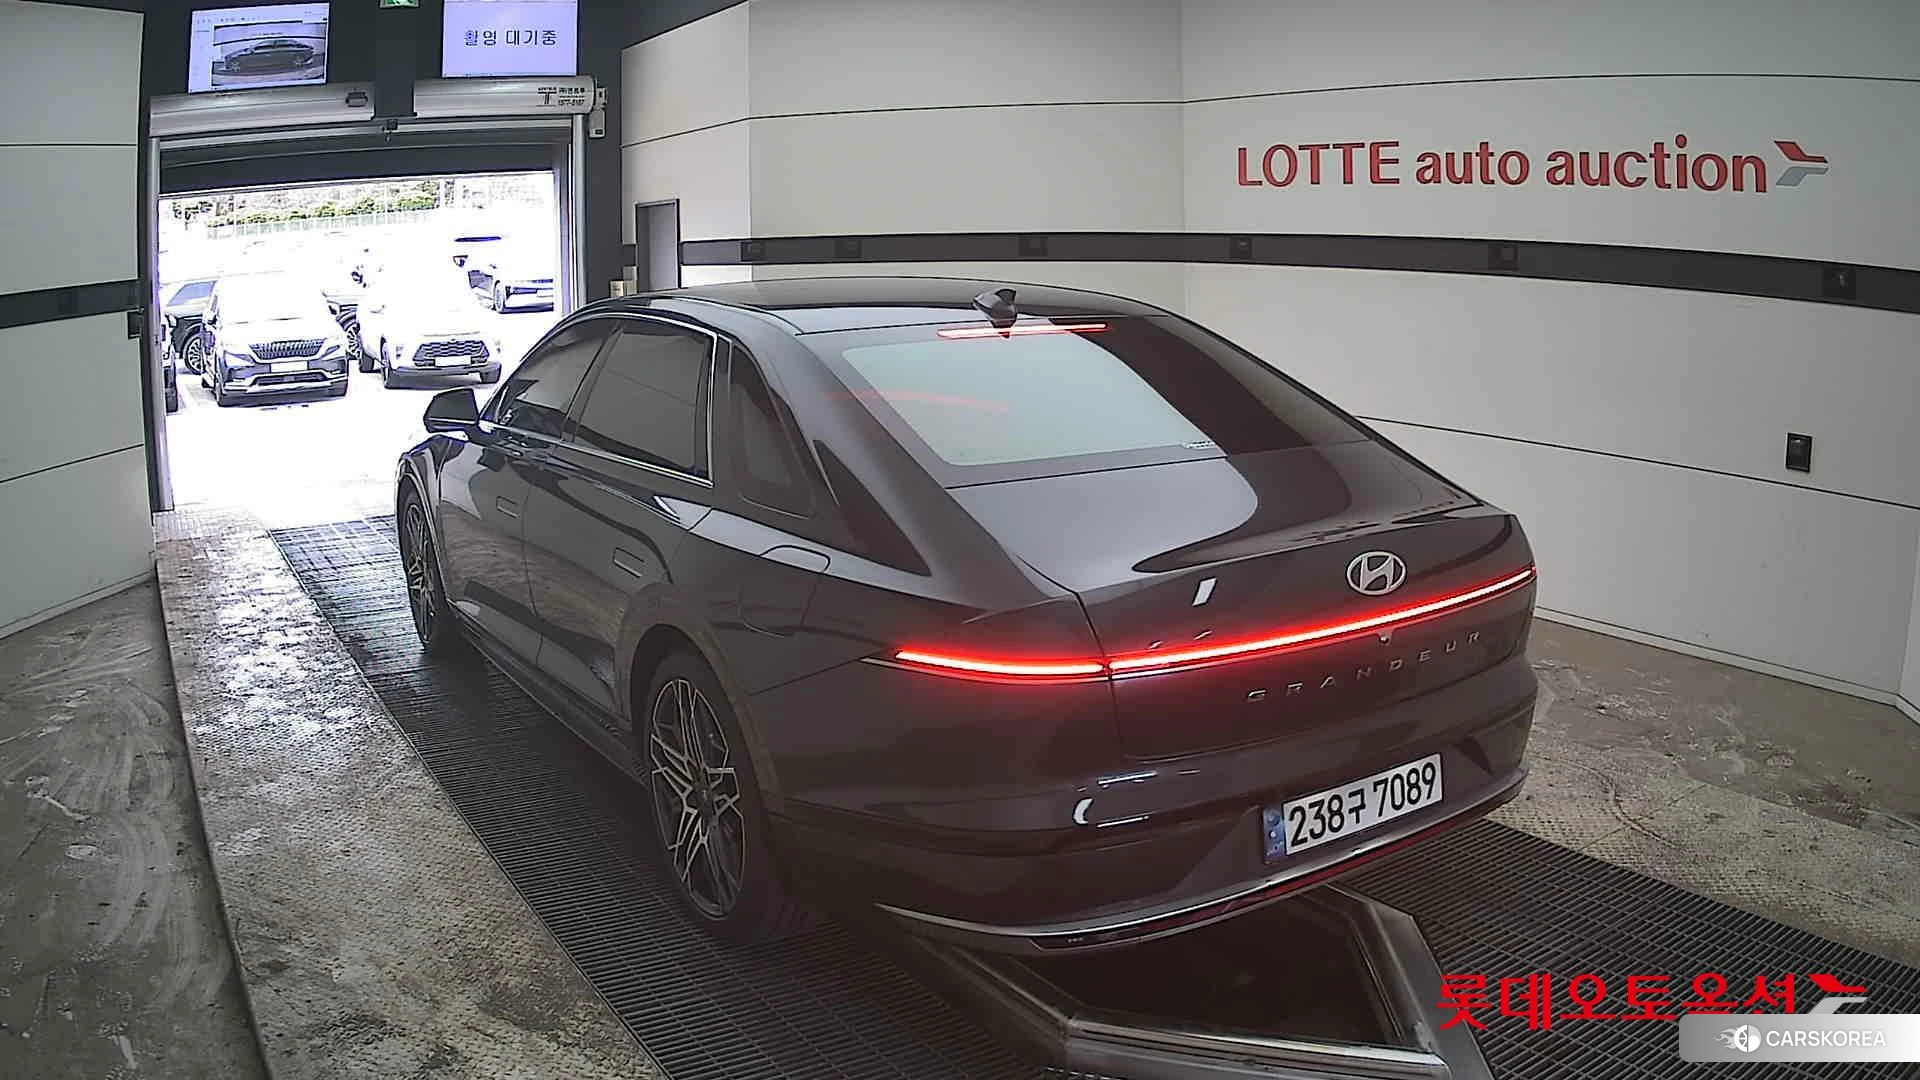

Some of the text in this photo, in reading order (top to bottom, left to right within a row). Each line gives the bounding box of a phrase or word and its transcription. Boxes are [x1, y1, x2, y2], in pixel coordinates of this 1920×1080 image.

[506, 30, 557, 46] 대기중
[1238, 134, 1767, 193] LOTTE auto auction
[1247, 631, 1480, 701] GRANDEUR
[1288, 762, 1436, 847] 238구 7089
